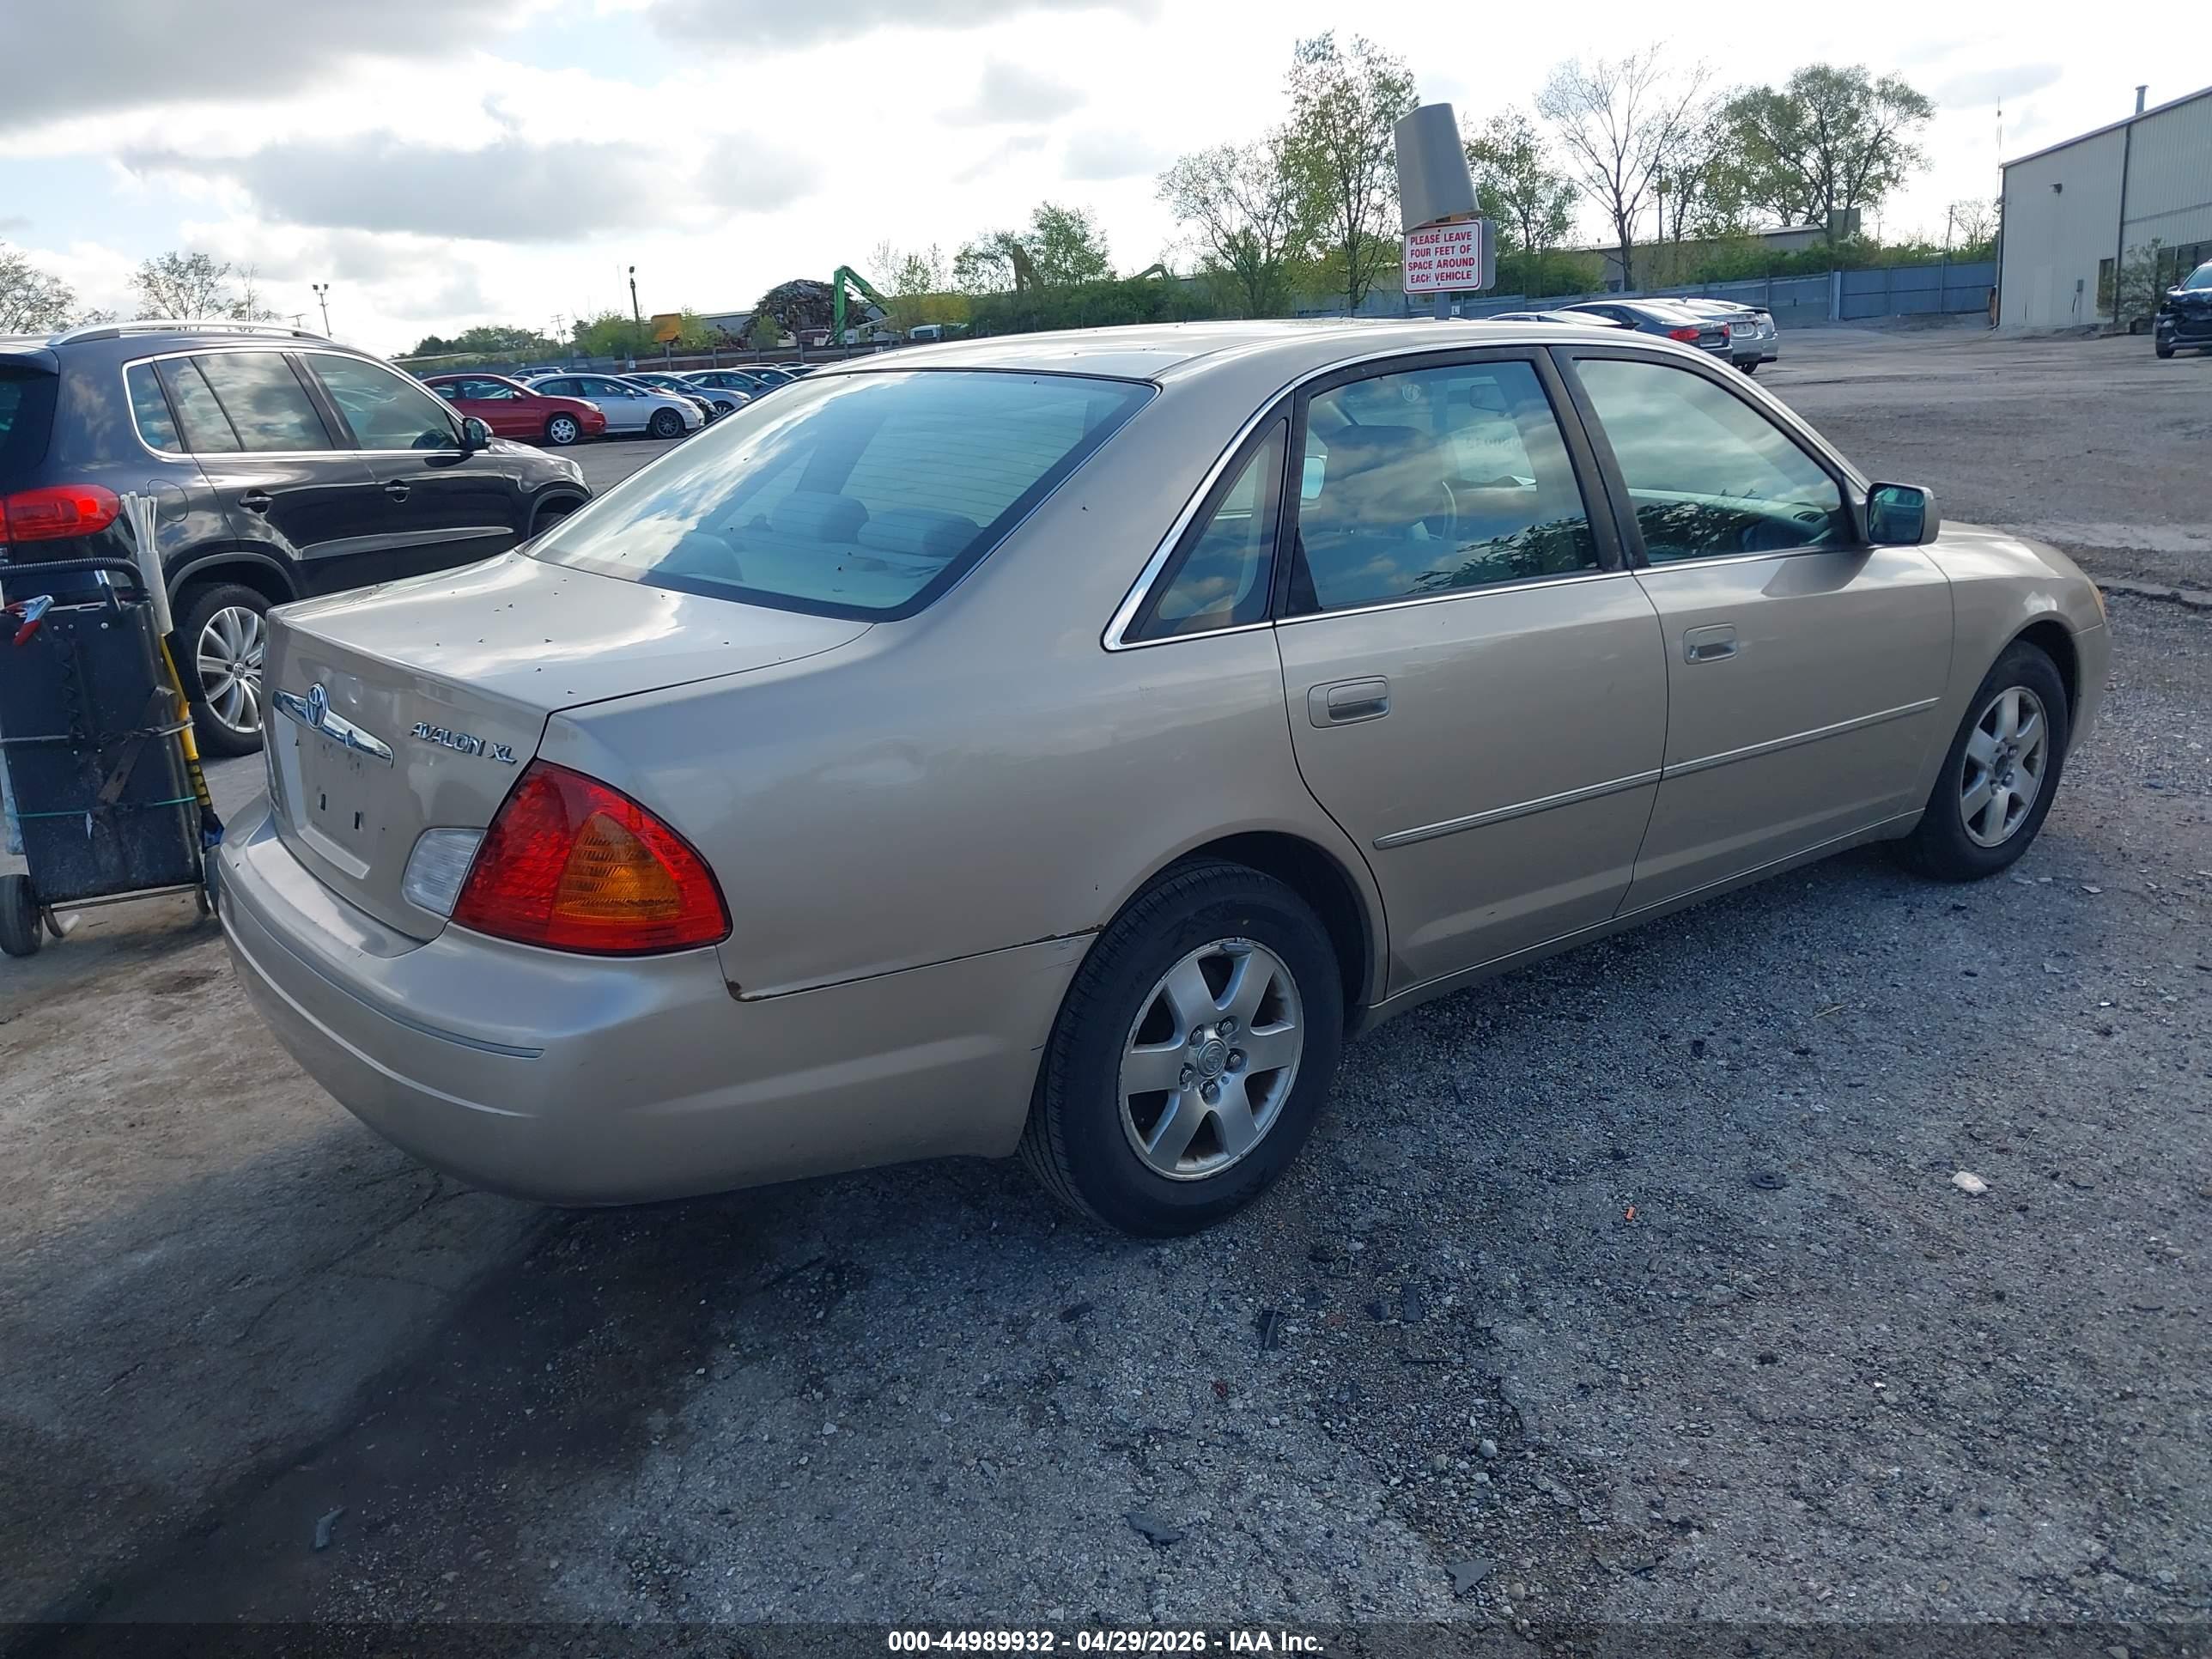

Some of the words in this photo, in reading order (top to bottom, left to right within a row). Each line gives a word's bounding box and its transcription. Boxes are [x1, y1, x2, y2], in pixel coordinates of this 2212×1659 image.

[1410, 234, 1440, 246] PLEASE
[1443, 231, 1473, 242] LEAVE
[1410, 247, 1431, 258] FOUR
[1434, 246, 1455, 256] FEET
[1460, 244, 1472, 254] OF
[1408, 260, 1433, 271] SPACE
[1436, 257, 1475, 269] AROUND
[1410, 273, 1431, 284] EACH
[1434, 270, 1473, 282] VEHICLE
[409, 721, 486, 757] AVALON
[487, 743, 518, 764] XL
